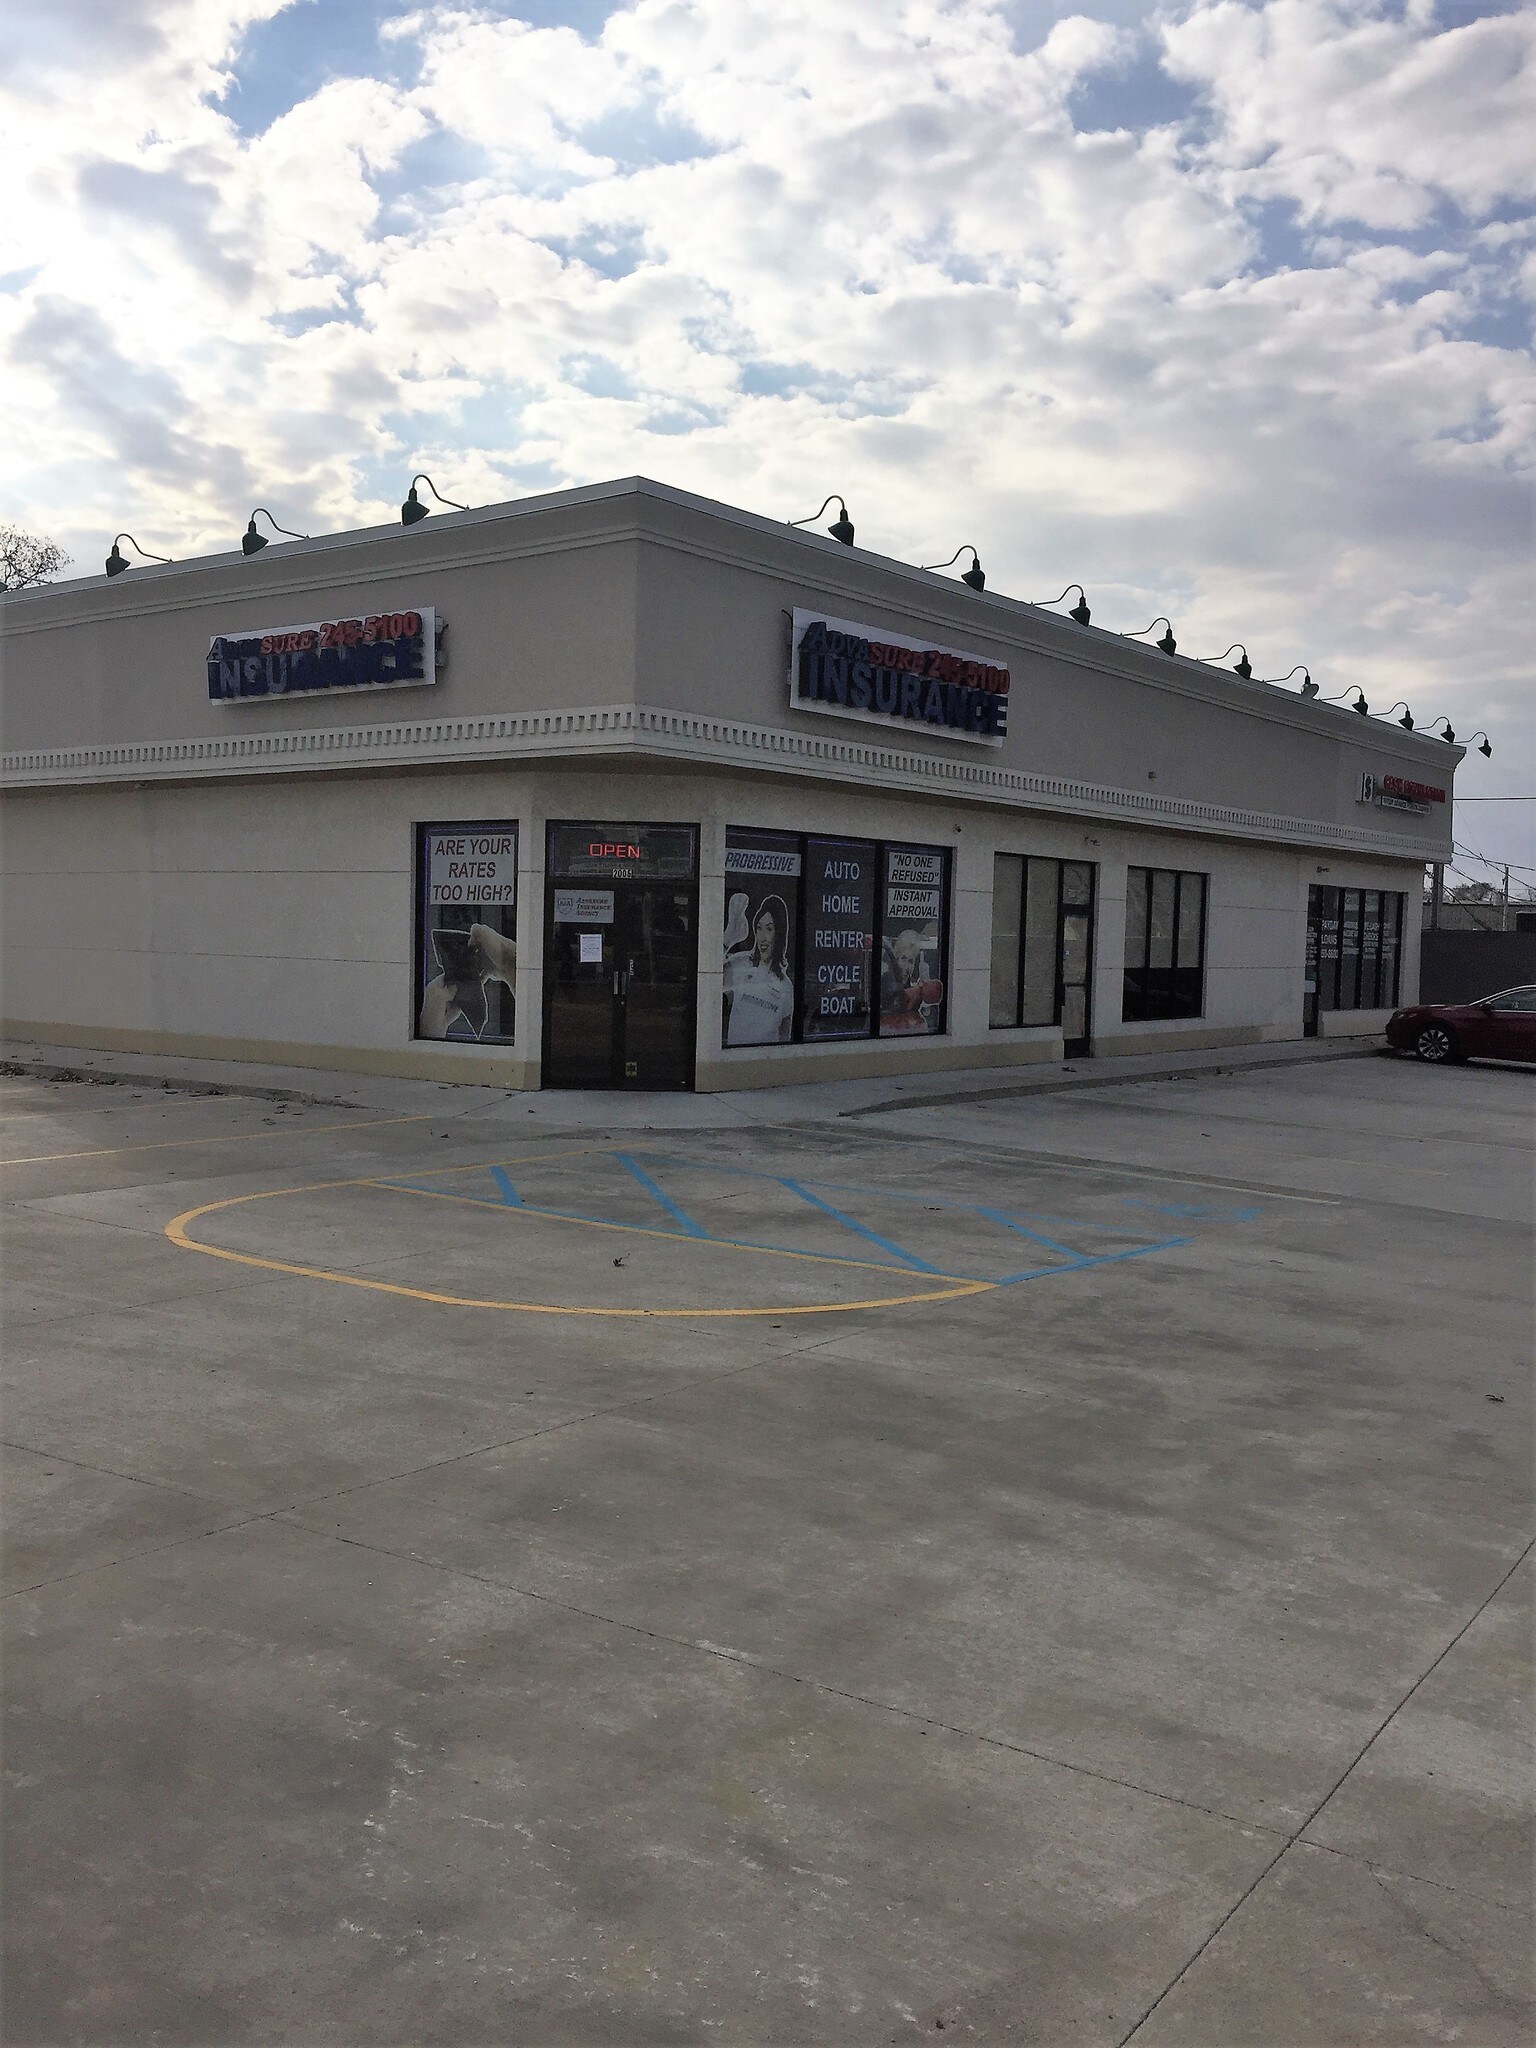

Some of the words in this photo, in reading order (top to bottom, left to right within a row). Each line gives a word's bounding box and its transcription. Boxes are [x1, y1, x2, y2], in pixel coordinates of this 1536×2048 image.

[434, 839, 465, 855] ARE
[470, 838, 512, 855] YOUR
[589, 843, 640, 859] OPEN
[448, 862, 496, 878] RATES
[725, 852, 795, 872] PROGRESSIVE
[913, 857, 933, 868] ONE
[824, 861, 860, 880] AUTO
[891, 869, 939, 883] REFUSED"
[433, 885, 463, 901] TOO
[466, 885, 512, 901] HIGH?
[893, 890, 932, 903] INSTANT
[822, 895, 860, 914] HOME
[888, 903, 938, 917] APPROVAL
[815, 930, 864, 948] RENTER
[818, 965, 860, 983] CYCLE
[821, 997, 856, 1015] BOAT
